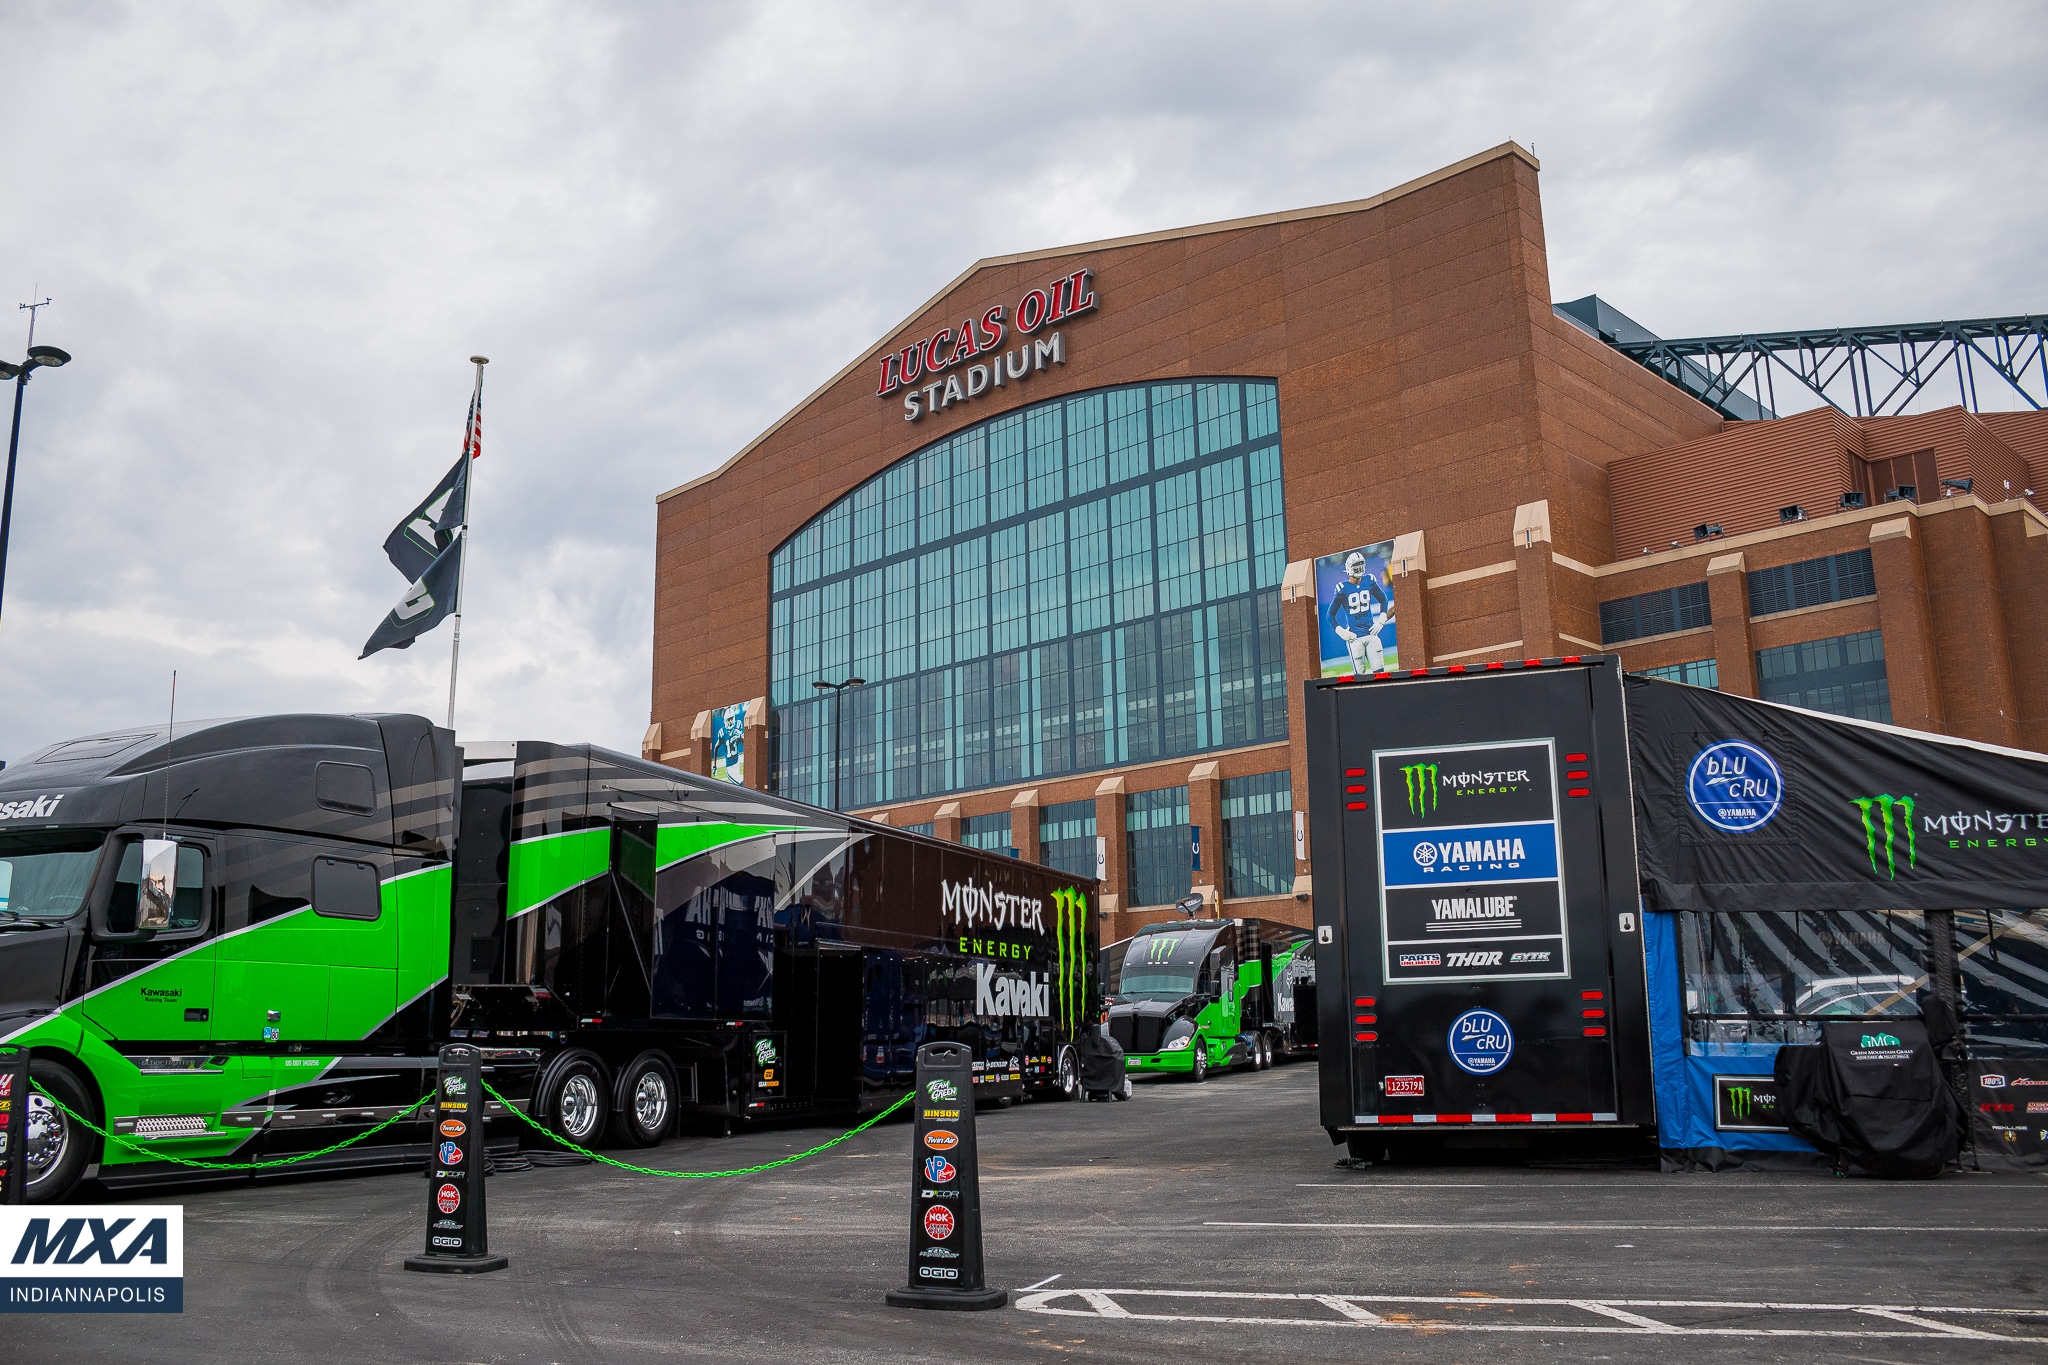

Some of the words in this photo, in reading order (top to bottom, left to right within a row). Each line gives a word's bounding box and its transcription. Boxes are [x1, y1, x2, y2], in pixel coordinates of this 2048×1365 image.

[876, 304, 1009, 397] LUCAS
[1016, 268, 1100, 334] OIL
[904, 331, 1066, 422] STADIUM
[1348, 590, 1371, 615] 99
[1707, 756, 1747, 776] bLU
[1442, 770, 1530, 788] MONSTER
[1456, 786, 1518, 796] ENERGY
[1729, 779, 1769, 798] cRU
[0, 794, 65, 820] saki
[1726, 808, 1757, 817] YAMAHA
[1438, 838, 1526, 864] YAMAHA
[1423, 862, 1520, 873] RACING
[941, 877, 1045, 936] MONSTER
[1431, 896, 1515, 920] YAMALUBE
[959, 937, 1032, 960] ENERGY
[1446, 951, 1503, 967] THOR
[140, 987, 182, 996] Kawasaki
[1462, 1018, 1492, 1033] bLU
[756, 1039, 772, 1054] TEAM
[1476, 1035, 1507, 1050] cRU
[1861, 1035, 1899, 1048] GMG
[443, 1076, 462, 1088] TEAM
[926, 1080, 950, 1092] TEAM
[1392, 1081, 1423, 1091] 123579A
[1984, 1077, 2002, 1085] 100%
[931, 1087, 957, 1102] GREEN
[924, 1110, 959, 1118] HINSON
[1980, 1103, 2014, 1112] KYB
[927, 1136, 943, 1144] Twin
[943, 1136, 956, 1144] Air
[440, 1141, 456, 1164] VP
[925, 1156, 947, 1182] VP
[441, 1190, 456, 1198] NGK
[929, 1213, 949, 1222] NGK
[433, 1236, 462, 1247] OGIO
[919, 1266, 959, 1280] OGIO
